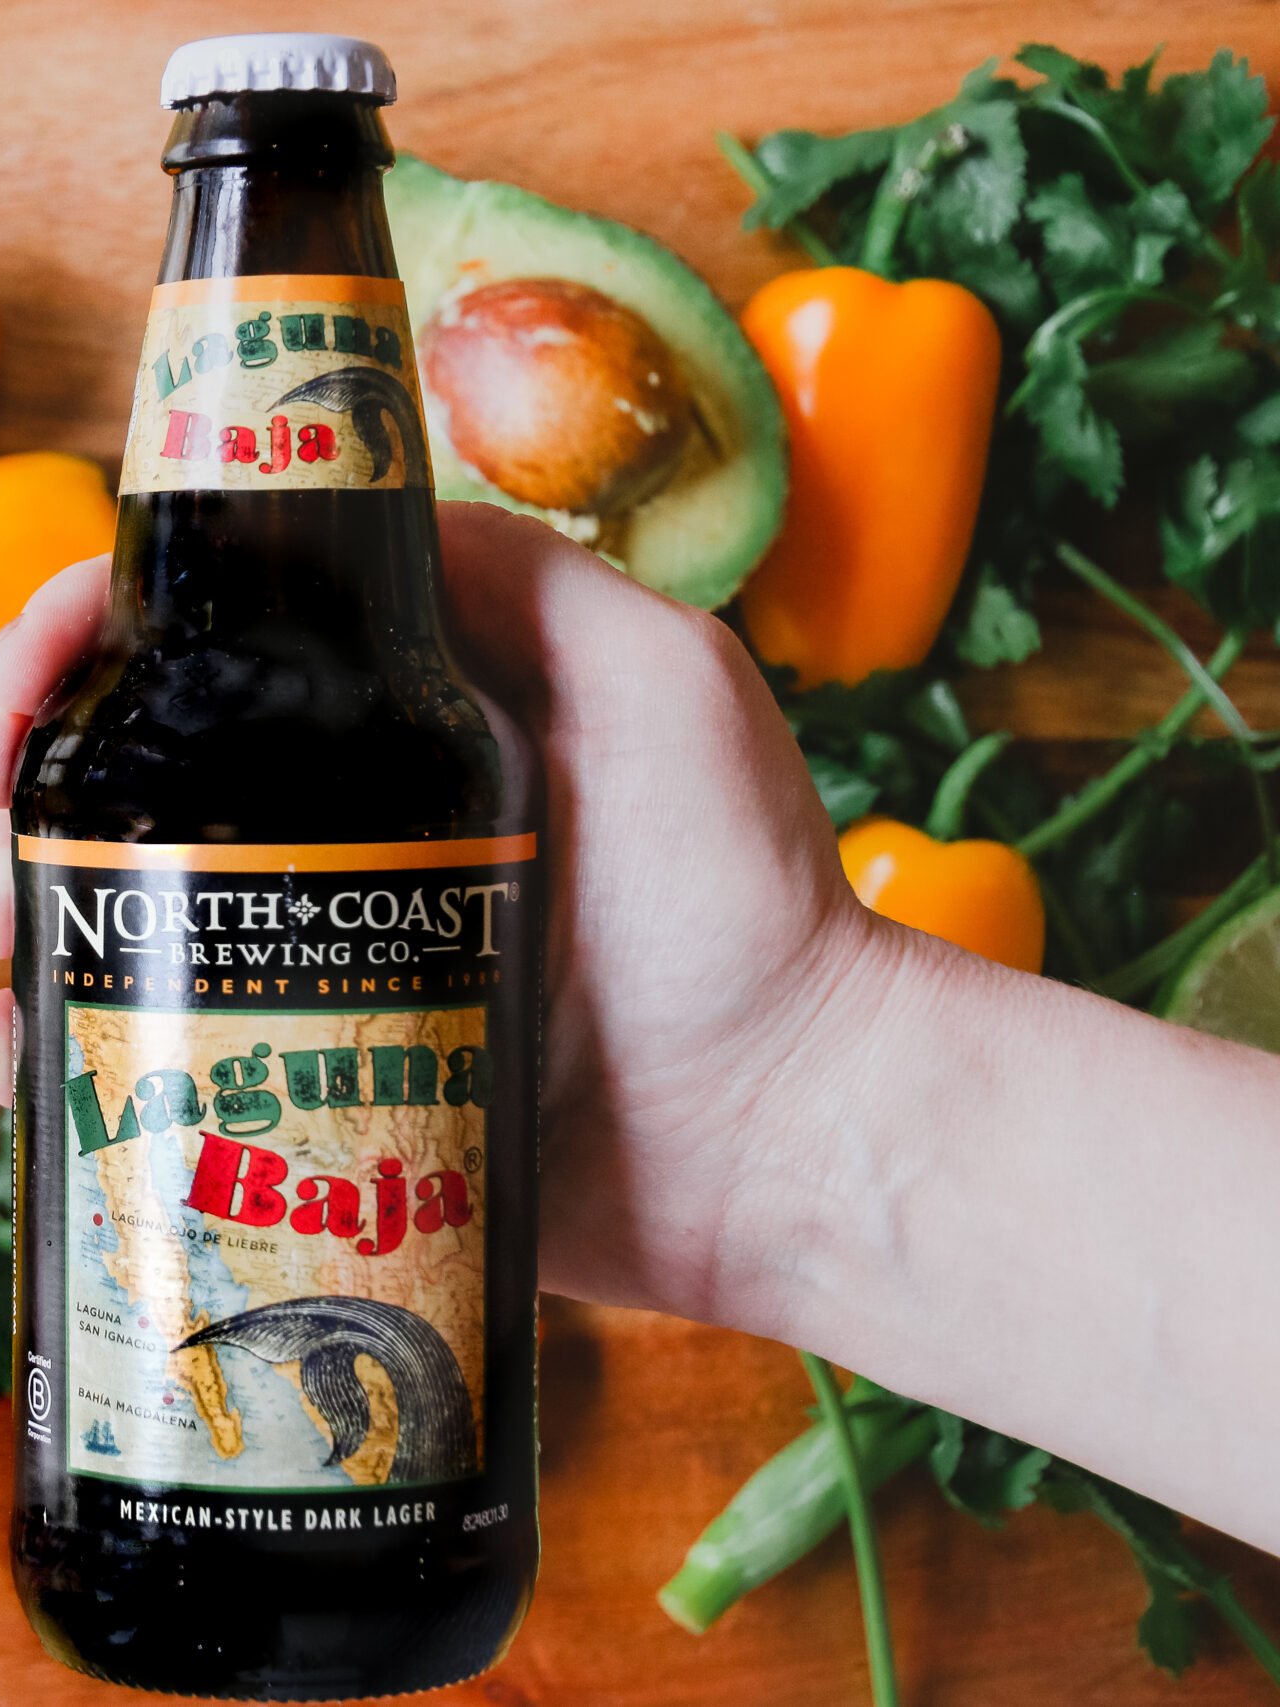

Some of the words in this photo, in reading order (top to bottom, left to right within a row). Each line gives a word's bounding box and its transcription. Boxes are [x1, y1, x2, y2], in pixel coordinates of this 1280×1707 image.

[151, 310, 403, 402] Laguna
[160, 409, 341, 475] Baja
[50, 885, 284, 960] NORTH
[169, 941, 351, 967] BREWING
[367, 940, 420, 964] CO.
[53, 969, 289, 995] INDEPENDENT
[318, 975, 423, 994] SINCE
[61, 1042, 494, 1157] Laguna
[111, 1210, 162, 1232] LAGUNA
[170, 1225, 197, 1241] OJO
[202, 1231, 221, 1245] DE
[227, 1235, 279, 1254] LIEBRE
[76, 1301, 122, 1326] LAGUNA
[79, 1320, 100, 1337] SAN
[104, 1329, 157, 1353] IGNACIO
[27, 1350, 52, 1369] Certified
[78, 1386, 111, 1408] BAHÍA
[116, 1401, 198, 1431] MAGDALENA
[120, 1499, 293, 1532] MEXICAN-STYLE
[305, 1508, 362, 1531] DARK
[374, 1501, 437, 1528] LAGER
